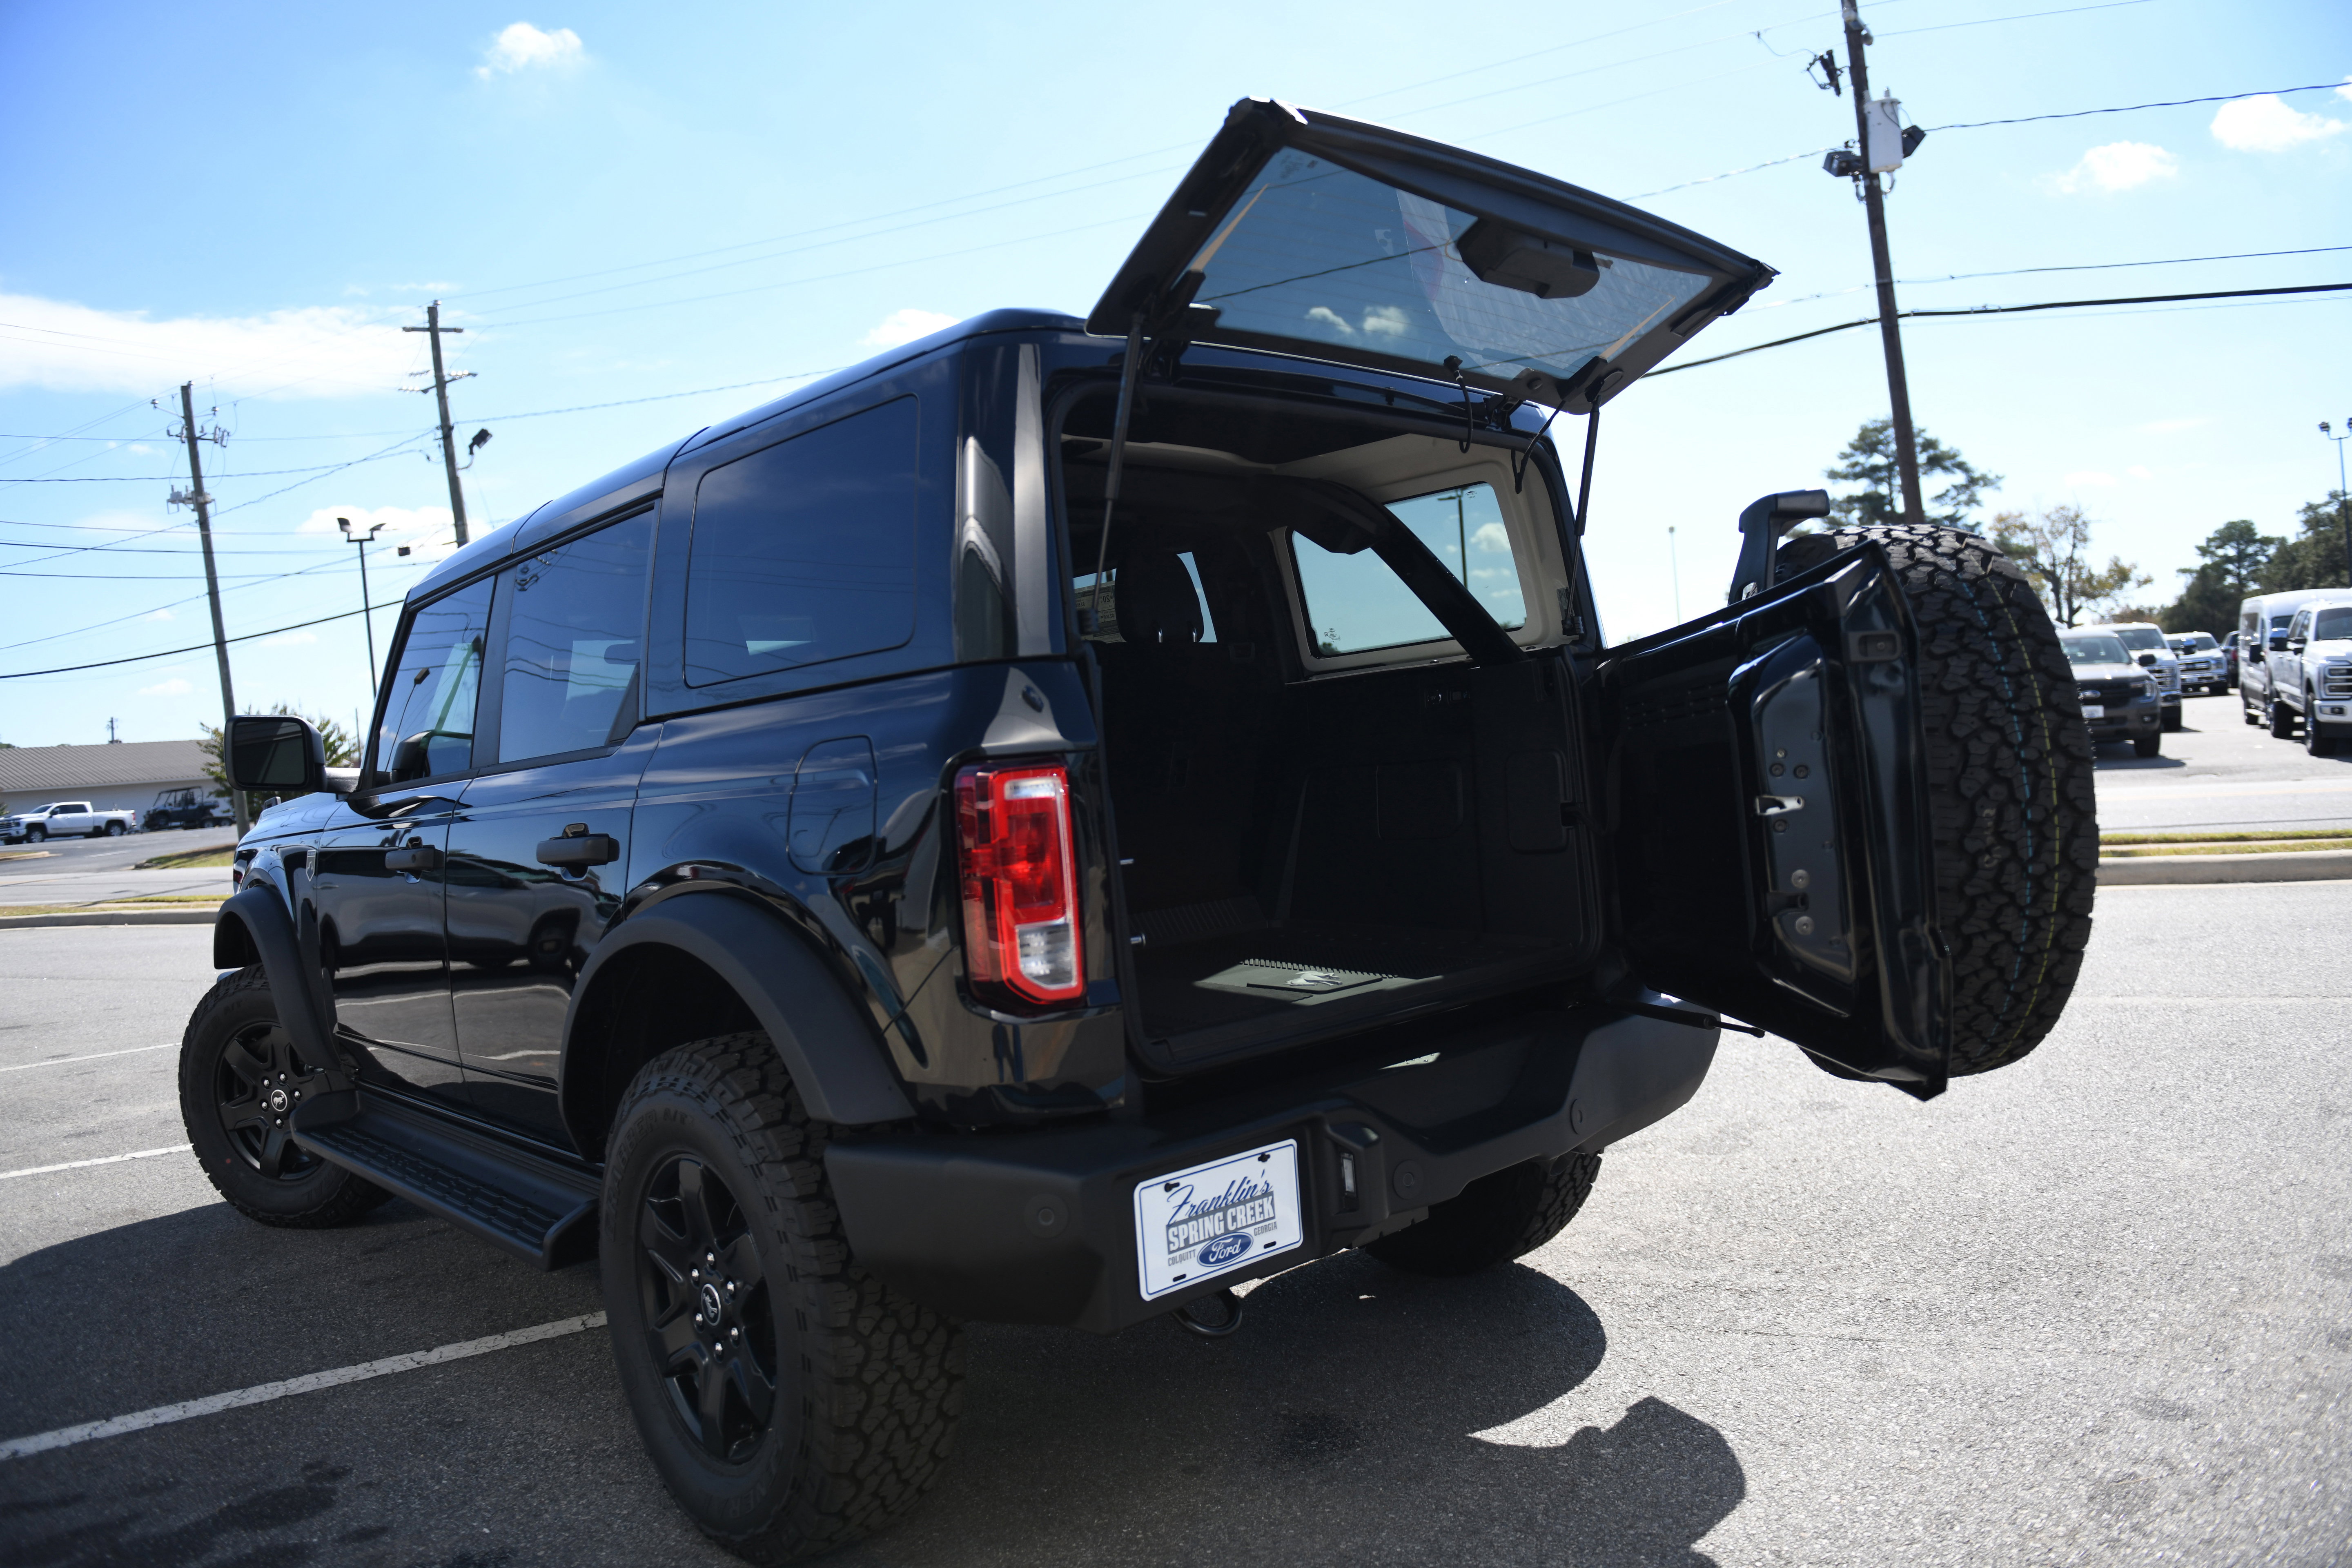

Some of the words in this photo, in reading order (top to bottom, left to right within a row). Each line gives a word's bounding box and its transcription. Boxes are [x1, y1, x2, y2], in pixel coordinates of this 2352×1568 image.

[605, 1109, 658, 1242] GRABBER
[1167, 1169, 1274, 1225] Franklin's
[1169, 1212, 1224, 1252] SPRING
[1227, 1196, 1275, 1230] CREEK
[1254, 1221, 1277, 1236] GEORGIA
[1168, 1249, 1196, 1267] COLQUITT
[1209, 1237, 1241, 1262] Ford
